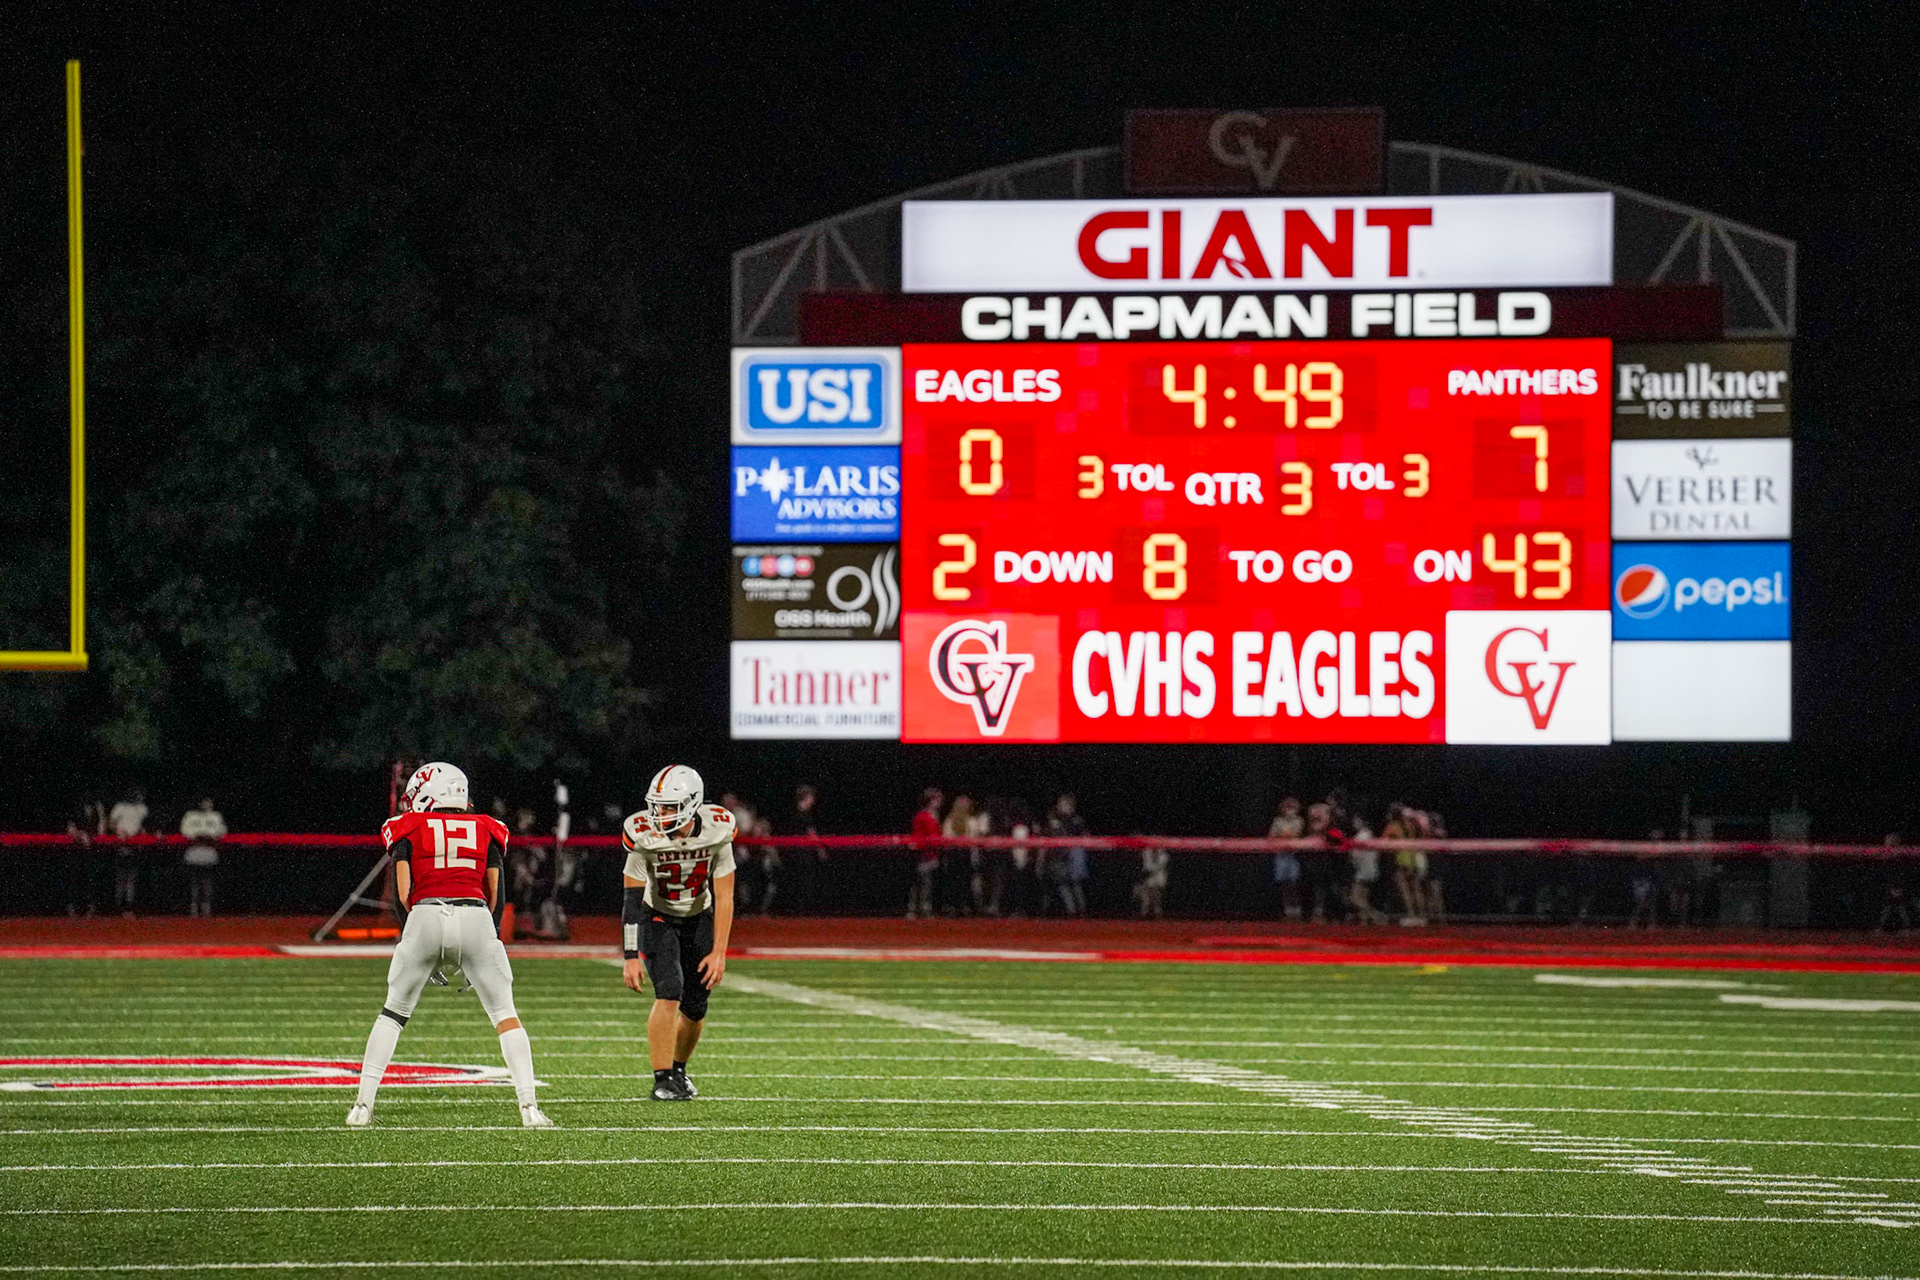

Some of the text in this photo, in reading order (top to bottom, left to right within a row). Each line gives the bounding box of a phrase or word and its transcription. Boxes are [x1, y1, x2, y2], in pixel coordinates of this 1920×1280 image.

[1208, 110, 1296, 190] CV
[1077, 206, 1433, 281] GIANT
[961, 291, 1553, 341] CHAPMAN FIELD
[757, 368, 874, 424] USI
[914, 369, 1062, 404] EAGLES
[1162, 361, 1344, 430] 4:49
[1447, 367, 1599, 396] PANTHERS
[1616, 362, 1789, 401] Faulkner
[1646, 399, 1756, 421] TO BE SURE
[958, 428, 1004, 497] 0
[1077, 454, 1176, 500] 3 TOL
[1330, 453, 1431, 498] TOL 3
[1509, 425, 1549, 494] 7
[776, 497, 898, 520] ADVISORS
[1184, 461, 1314, 517] QTR 3
[1624, 474, 1779, 506] VERBER
[1648, 508, 1756, 533] DENTAL
[932, 533, 1114, 601] 2 DOWN
[1142, 532, 1353, 601] 8 TO GO
[1412, 531, 1573, 600] ON 43
[1674, 570, 1785, 613] pepsi
[742, 656, 891, 707] Tanner
[929, 619, 1036, 737] CV
[1072, 629, 1436, 719] CVHS EAGLES
[1484, 627, 1577, 731] CV
[426, 819, 477, 869] 12
[655, 860, 710, 901] 24
